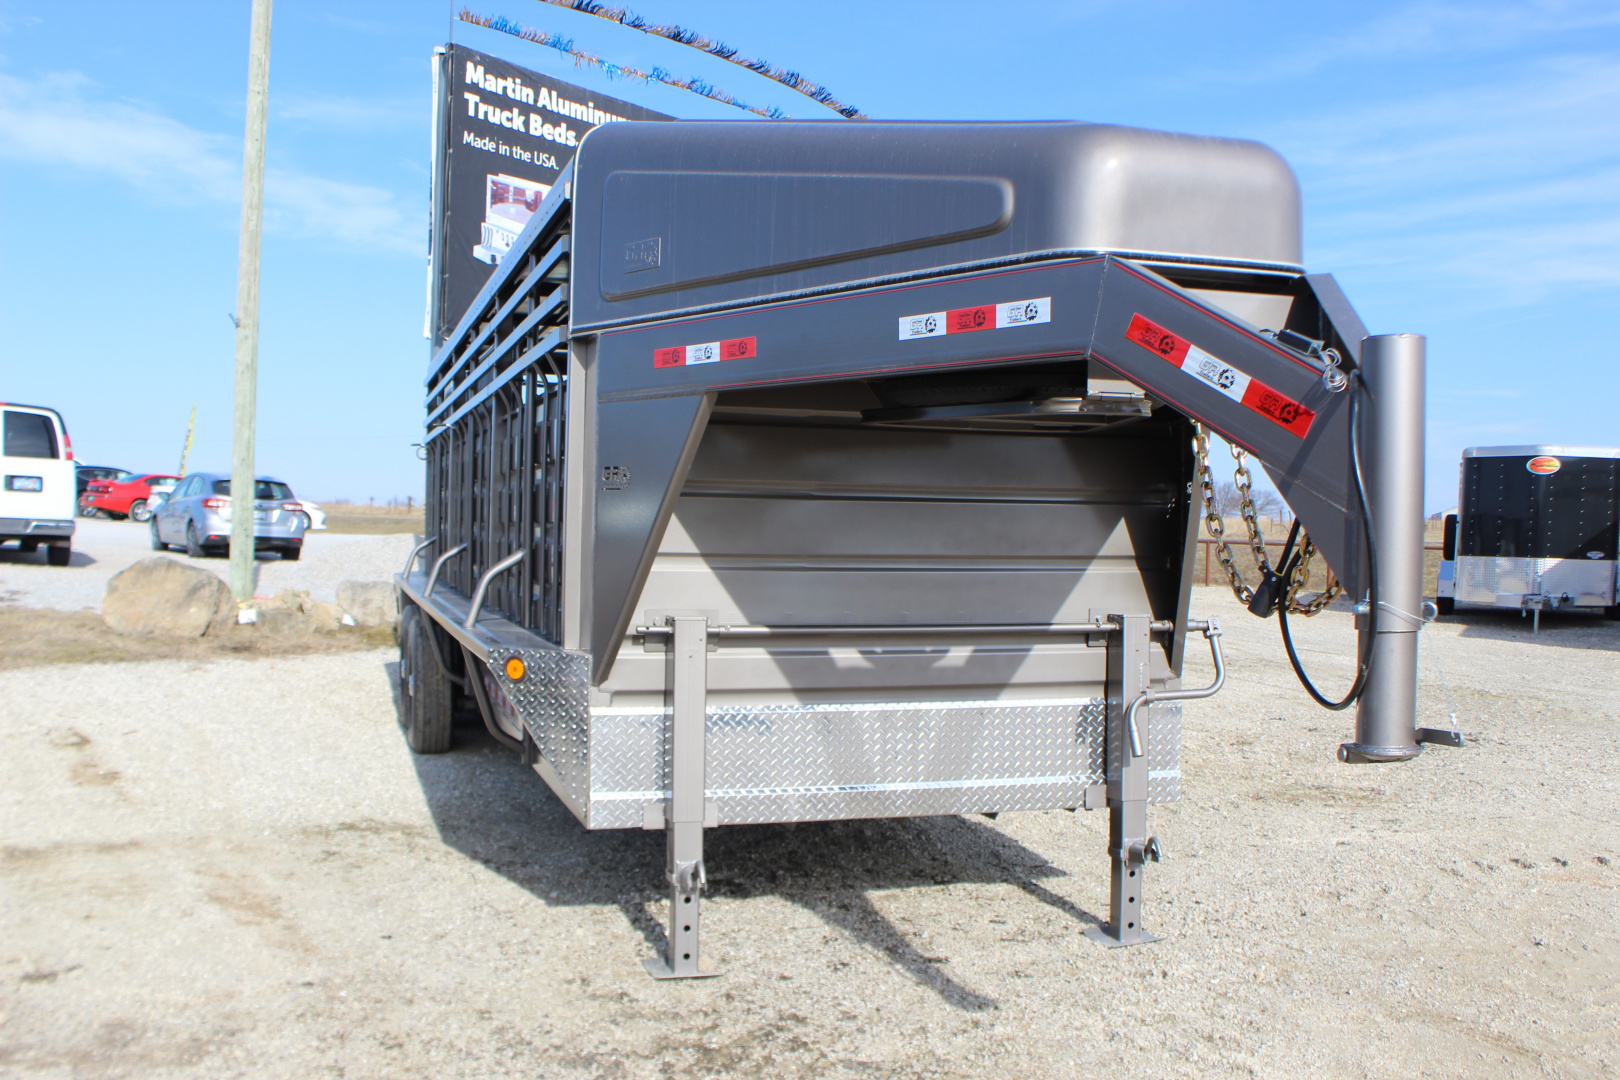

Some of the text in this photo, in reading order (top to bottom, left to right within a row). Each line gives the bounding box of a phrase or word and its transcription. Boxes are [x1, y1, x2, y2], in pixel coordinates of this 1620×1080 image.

[463, 91, 526, 133] Truck
[465, 60, 631, 125] Martin Alumin
[462, 130, 560, 170] Made in the USA.
